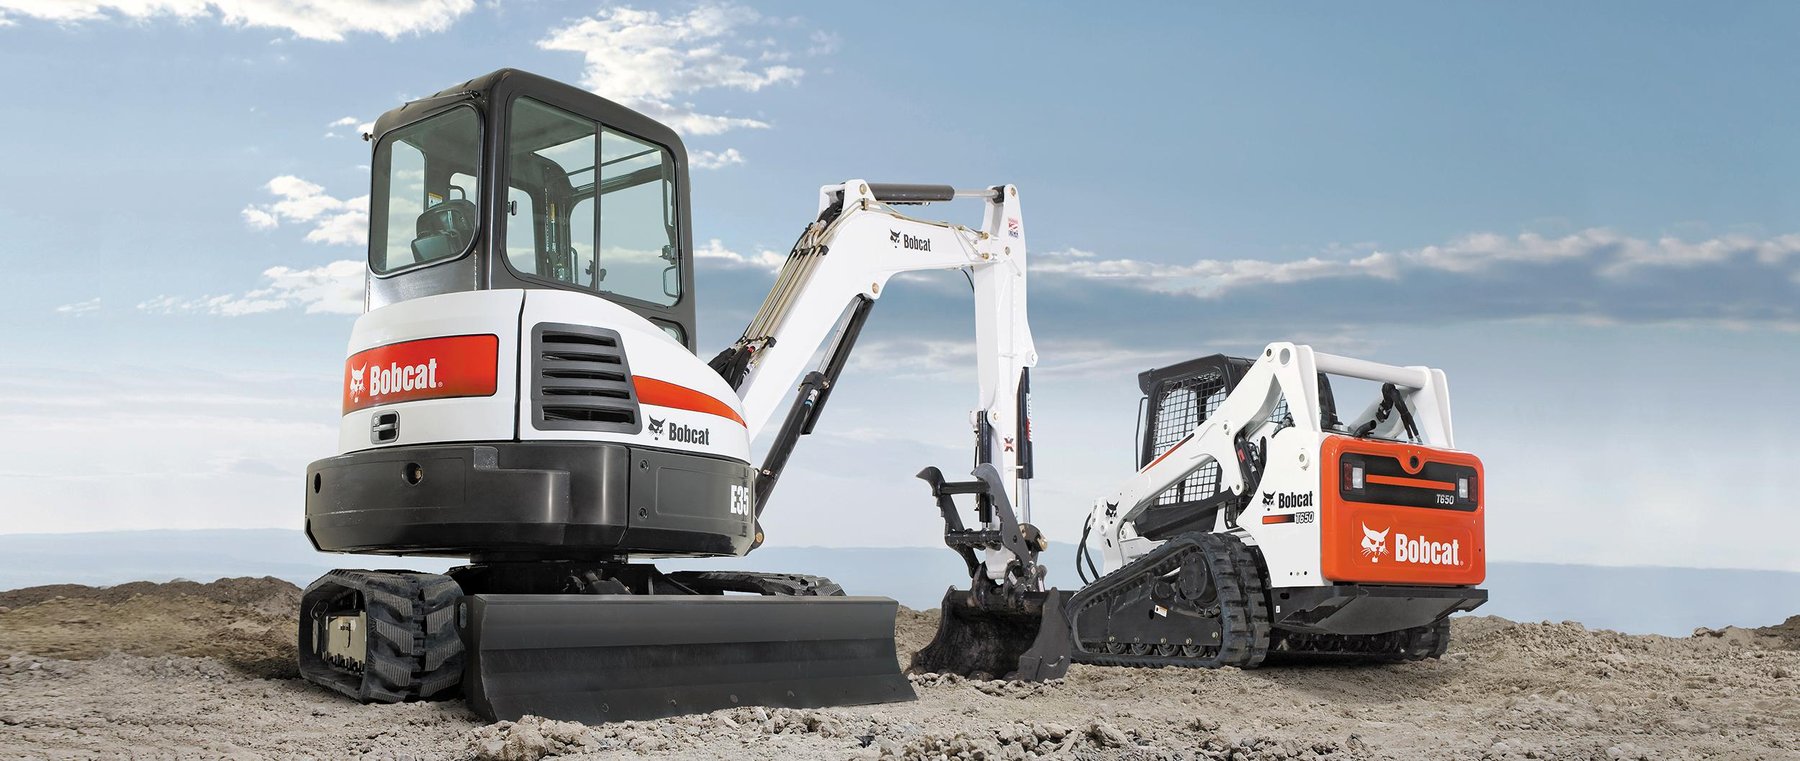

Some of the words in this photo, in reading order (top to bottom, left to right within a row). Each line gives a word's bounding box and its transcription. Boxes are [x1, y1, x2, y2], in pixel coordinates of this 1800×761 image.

[903, 234, 931, 252] Bobcat
[369, 358, 438, 397] Bobcat
[668, 422, 710, 446] Bobcat
[730, 484, 749, 516] E35
[1278, 490, 1313, 509] Bobcat
[1436, 494, 1455, 505] T650
[1295, 511, 1315, 524] T650
[1395, 533, 1460, 566] Bobcat
